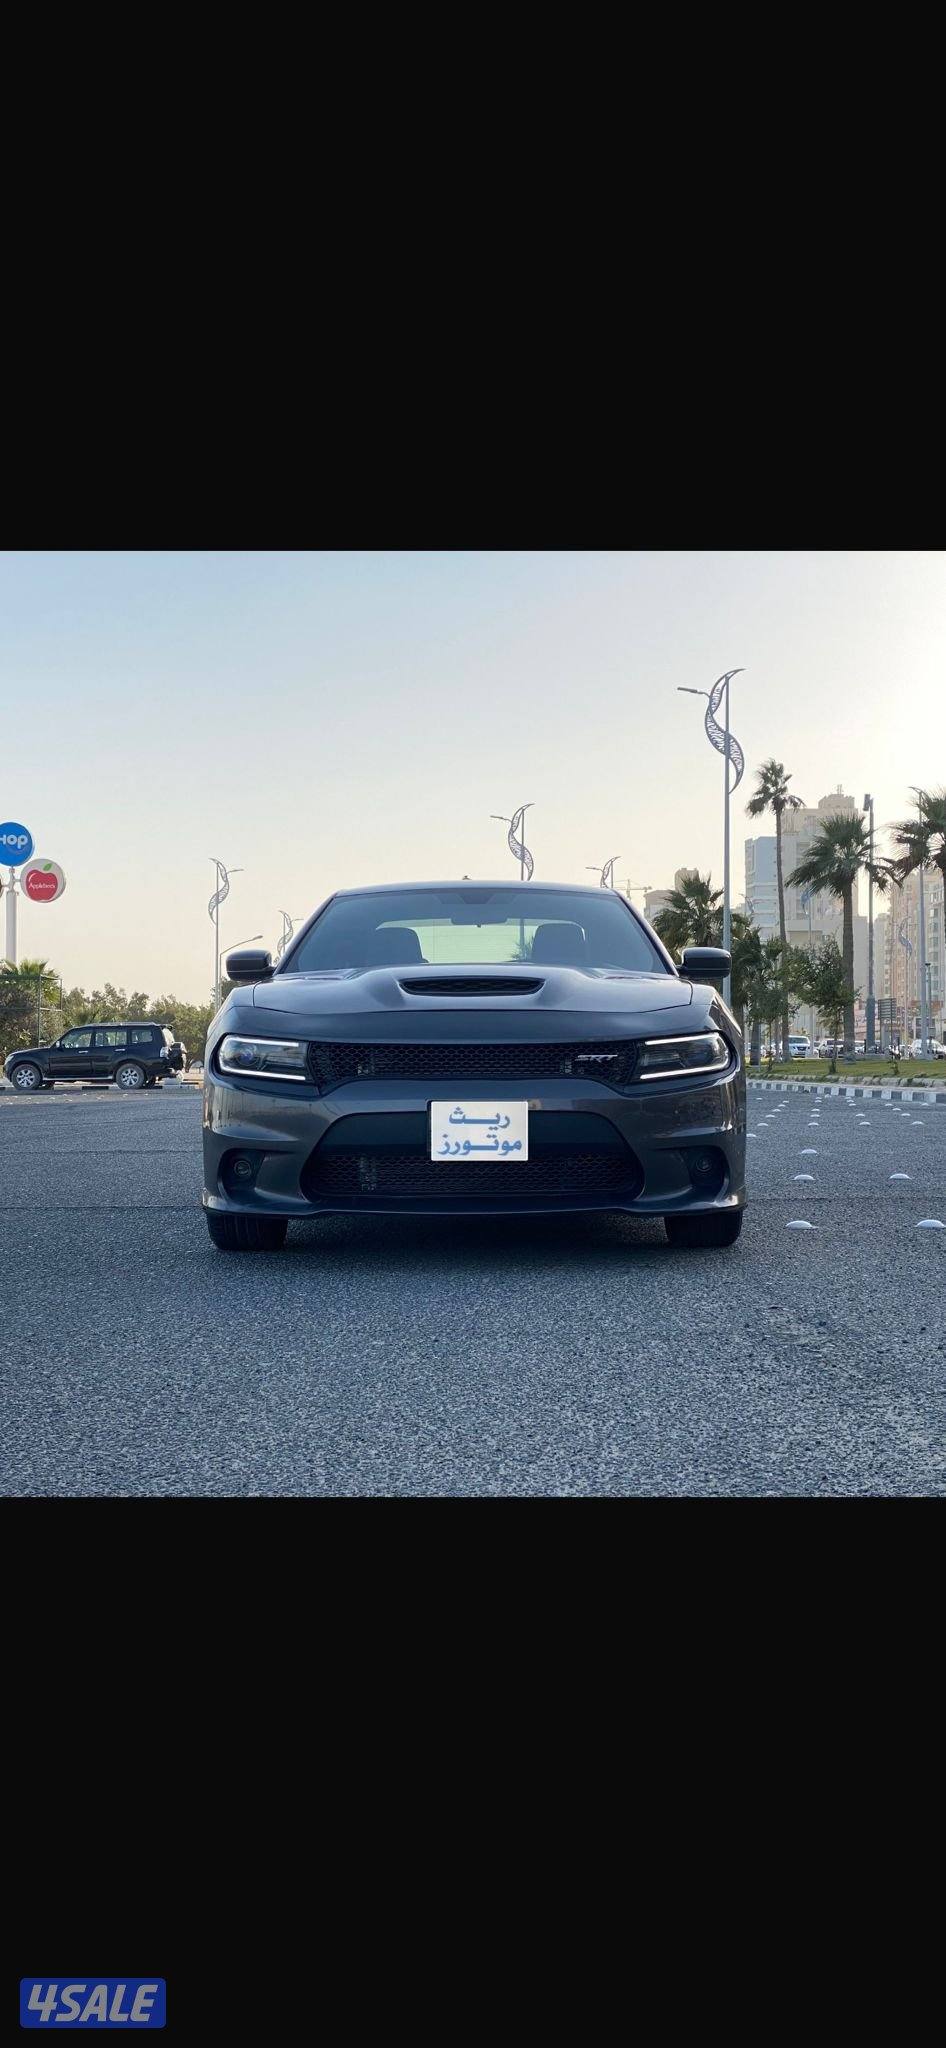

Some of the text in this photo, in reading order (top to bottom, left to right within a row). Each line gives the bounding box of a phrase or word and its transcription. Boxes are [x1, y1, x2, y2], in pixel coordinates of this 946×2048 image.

[575, 1054, 618, 1063] SRT
[448, 1106, 511, 1130] ريث
[437, 1133, 522, 1155] موتورز
